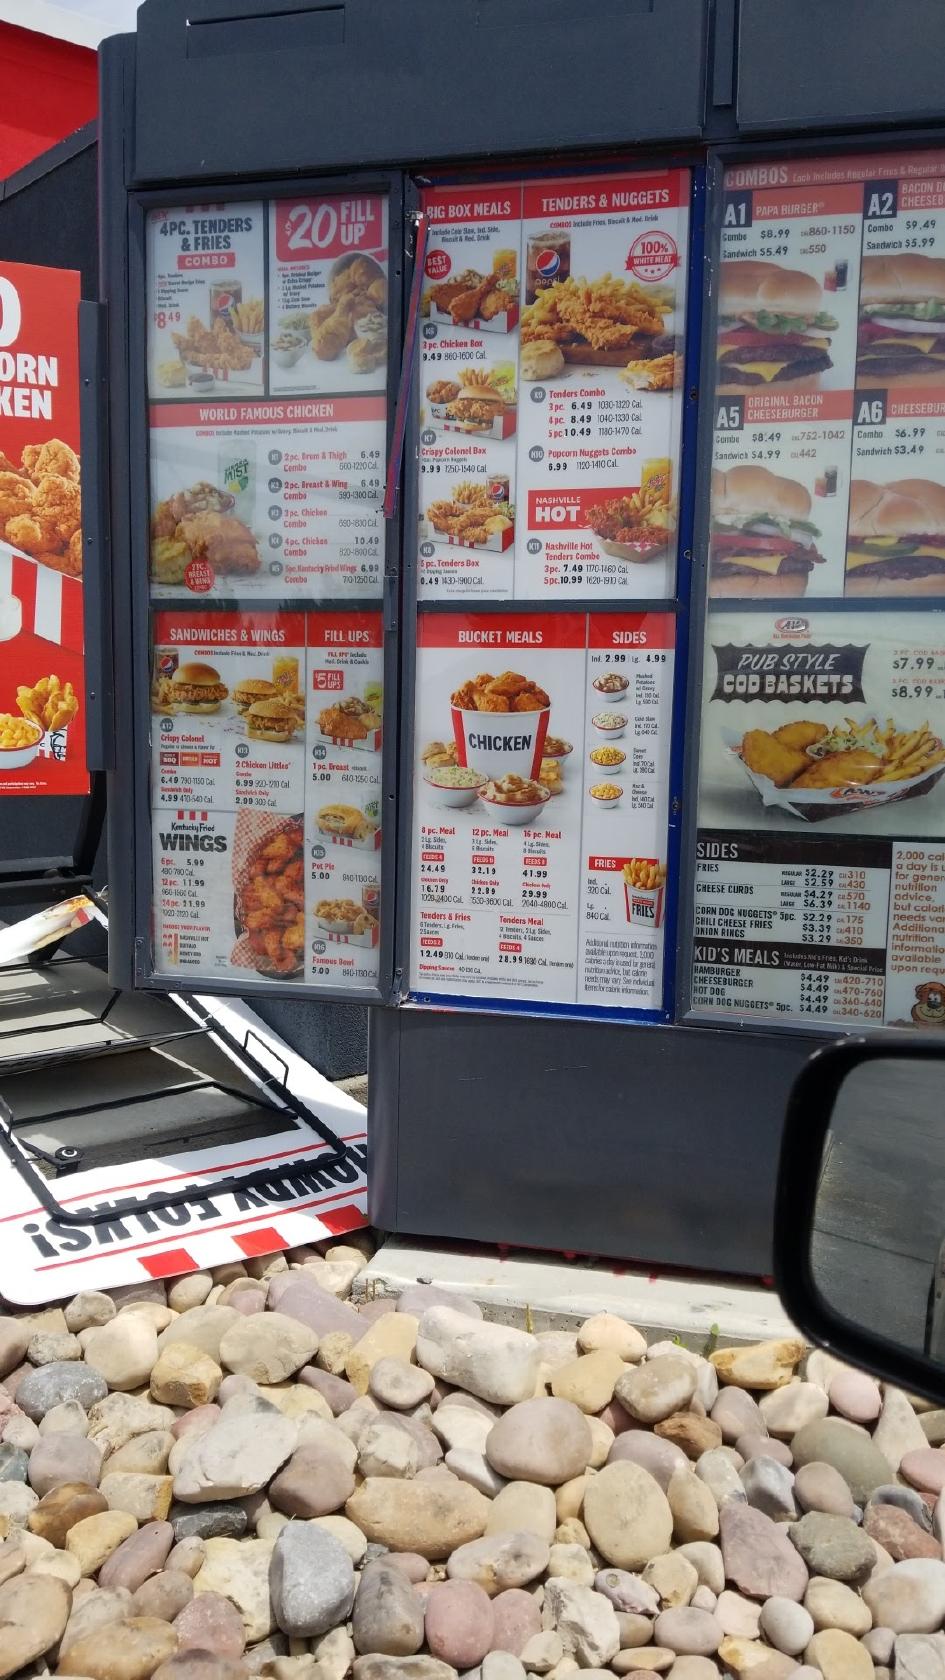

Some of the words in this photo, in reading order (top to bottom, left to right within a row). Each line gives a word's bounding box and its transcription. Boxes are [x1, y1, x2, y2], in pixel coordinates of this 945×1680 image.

[726, 168, 788, 187] COMBOS
[902, 183, 934, 193] BACON
[542, 195, 595, 211] TENDERS
[599, 195, 608, 207] &
[612, 190, 669, 206] NUGGETS
[868, 193, 893, 216] A2
[341, 200, 374, 221] FILL
[427, 205, 446, 217] BIG
[448, 204, 471, 216] BOX
[474, 201, 511, 215] MEALS
[756, 206, 779, 216] PAPA
[725, 204, 746, 225] A1
[160, 221, 190, 235] 4PC.
[193, 217, 252, 234] TENDERS
[868, 224, 893, 233] Combo
[906, 220, 936, 230] $9.49
[341, 223, 365, 245] UP
[761, 229, 790, 238] $8.99
[181, 238, 191, 252] &
[194, 235, 231, 251] FRIES
[641, 241, 668, 253] 100%
[867, 240, 902, 249] Sandwich
[905, 238, 935, 248] $5.99
[760, 246, 788, 256] $5.49
[185, 257, 227, 266] COMBO
[428, 256, 446, 266] BEST
[634, 257, 652, 265] WHITE
[428, 265, 447, 274] VALUE
[440, 340, 468, 348] Chicken
[423, 353, 442, 361] 9.49
[0, 352, 58, 386] ORN
[549, 389, 578, 398] Tenders
[581, 388, 605, 397] Combo
[0, 387, 52, 420] KEN
[572, 402, 592, 410] 6.49
[749, 396, 791, 407] ORIGINAL
[793, 395, 823, 405] BACON
[200, 409, 236, 421] WORLD
[240, 406, 283, 419] FAMOUS
[287, 404, 333, 417] CHICKEN
[717, 406, 740, 427] A5
[748, 408, 818, 419] CHEESEBURGER
[858, 401, 883, 424] A6
[571, 415, 591, 423] 8.49
[565, 428, 591, 437] 10.49
[752, 432, 781, 442] $8.49
[857, 430, 883, 439] Combo
[895, 428, 925, 438] $6.99
[421, 448, 443, 457] Crispy
[444, 447, 470, 455] Colonel
[473, 447, 486, 455] Box
[548, 450, 576, 458] Popcorn
[579, 449, 609, 457] Nuggets
[611, 447, 636, 456] Combo
[752, 450, 780, 459] $4.99
[856, 447, 892, 456] Sandwich
[894, 446, 924, 455] $3.49
[421, 465, 441, 473] 9.99
[548, 462, 567, 471] 6.99
[331, 480, 348, 489] Wing
[361, 479, 380, 487] 6.49
[536, 506, 580, 522] HOT
[546, 542, 577, 551] Nashville
[581, 542, 592, 550] Hot
[546, 552, 573, 560] Tenders
[576, 552, 599, 560] Combo
[437, 559, 464, 567] Tenders
[466, 559, 479, 567] Box
[563, 564, 583, 572] 7.49
[560, 576, 582, 584] 10.99
[170, 628, 237, 641] SANDWICHES
[240, 629, 248, 641] &
[251, 630, 285, 641] WINGS
[325, 631, 346, 641] FILL
[348, 631, 369, 642] UPS
[458, 631, 501, 644] BUCKET
[506, 631, 542, 644] MEALS
[613, 632, 646, 644] SIDES
[605, 655, 626, 663] 2.99
[646, 655, 666, 663] 4.99
[738, 654, 773, 670] PUB
[780, 654, 840, 670] STYLE
[893, 658, 934, 670] $7.99
[724, 675, 760, 694] COD
[765, 675, 853, 694] BASKETS
[892, 686, 933, 698] $8.99
[161, 734, 179, 742] Crispy
[469, 733, 531, 752] CHICKEN
[171, 823, 197, 832] Kentucky
[439, 827, 455, 835] Meal
[493, 829, 508, 837] Meal
[545, 831, 561, 839] Meal
[159, 833, 227, 852] WINGS
[697, 843, 738, 859] SIDES
[897, 851, 924, 860] 2,000
[595, 859, 616, 868] FRIES
[697, 863, 719, 872] FRIES
[312, 872, 330, 880] 5.00
[523, 870, 547, 878] 41.99
[805, 869, 833, 878] $2.29
[183, 879, 204, 887] 11.99
[805, 878, 833, 887] $2.59
[895, 883, 937, 892] nutrition
[522, 889, 547, 898] 29.99
[697, 884, 725, 893] CHEESE
[728, 886, 753, 894] CURDS
[804, 890, 832, 899] $4.29
[804, 899, 832, 908] $6.39
[420, 912, 446, 920] Tenders
[455, 913, 471, 921] Fries
[631, 904, 654, 919] FRIES
[500, 916, 526, 925] Tenders
[528, 916, 544, 925] Meal
[695, 917, 715, 926] CHILI
[718, 918, 748, 928] CHEESE
[749, 921, 772, 929] FRIES
[695, 927, 719, 937] ONION
[721, 929, 745, 938] RINGS
[802, 924, 831, 933] $3.39
[802, 934, 831, 943] $3.29
[694, 947, 729, 962] KID'S
[734, 949, 779, 965] MEALS
[892, 954, 941, 964] available
[339, 958, 354, 966] Bowl
[694, 965, 740, 976] HAMBURGER
[694, 976, 753, 987] CHEESEBURGER
[801, 973, 829, 983] $4.49
[694, 987, 708, 996] HOT
[710, 987, 725, 996] DOG
